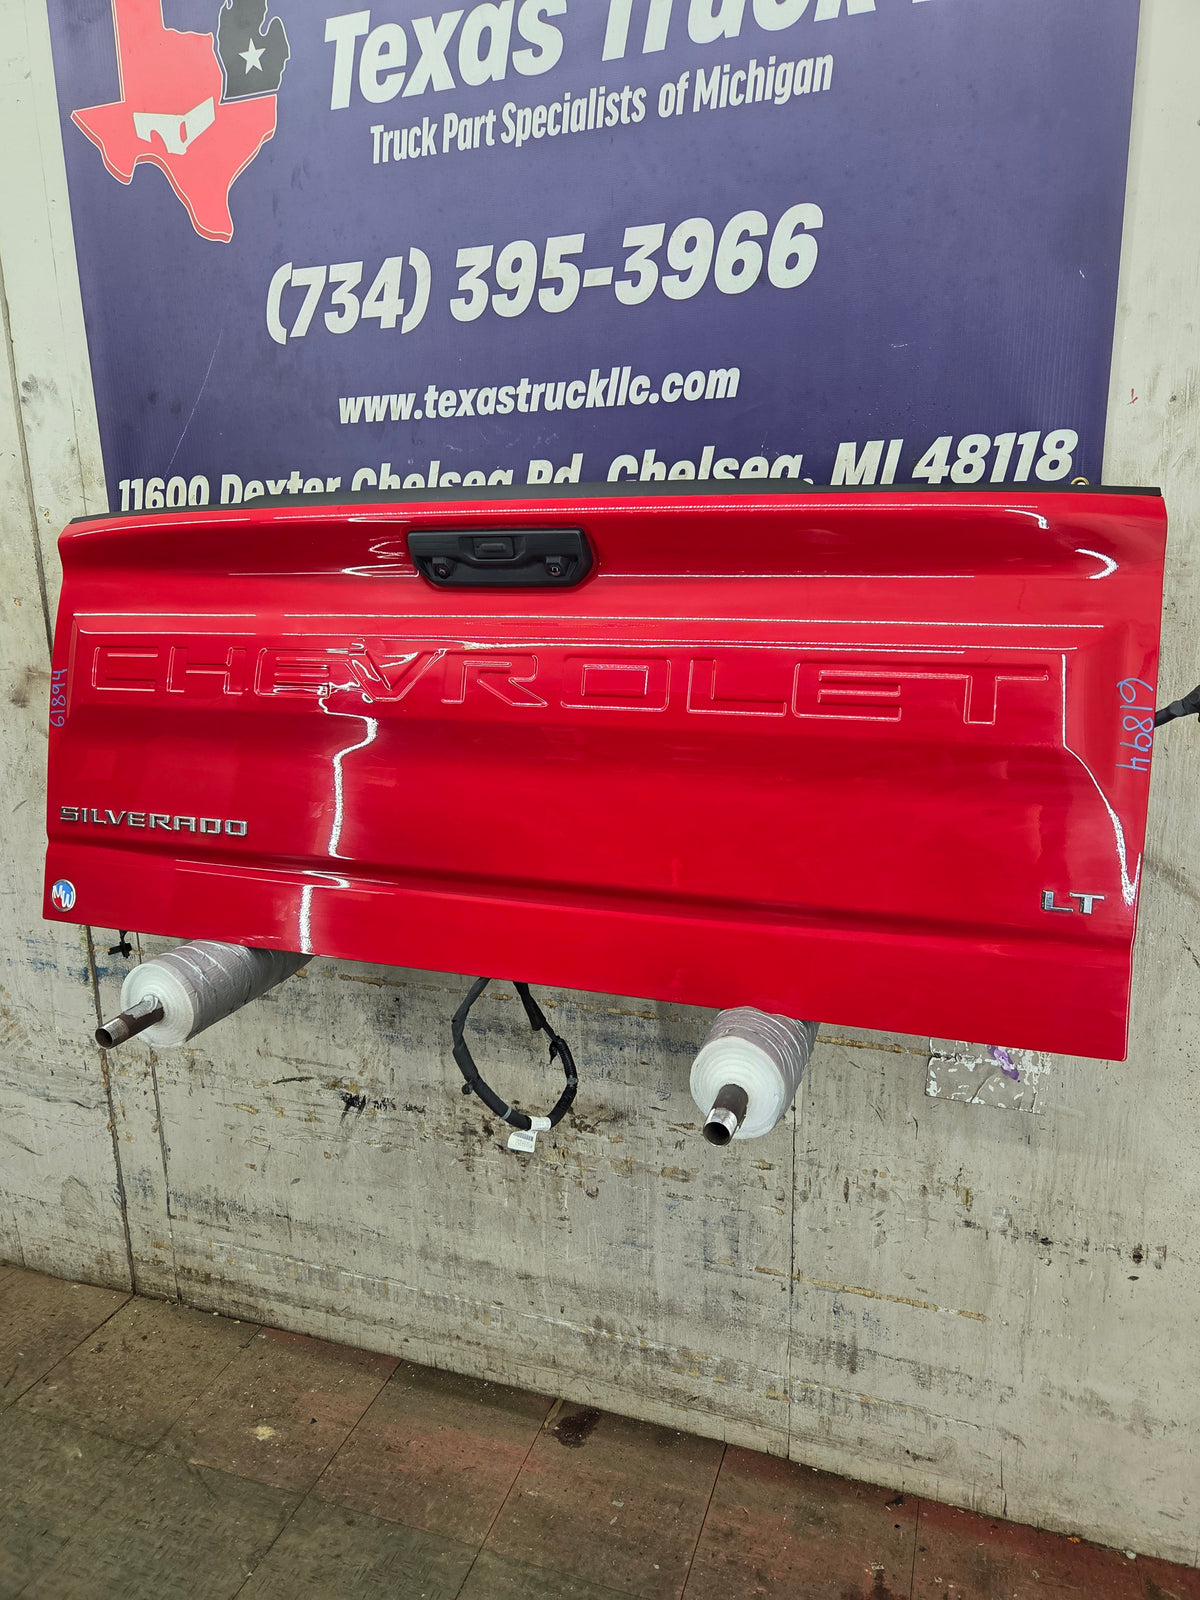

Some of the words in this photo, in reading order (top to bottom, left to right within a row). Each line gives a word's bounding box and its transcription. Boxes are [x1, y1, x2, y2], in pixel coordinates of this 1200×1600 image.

[324, 0, 567, 111] Texas
[601, 0, 877, 62] Tru
[370, 117, 438, 164] Truck
[442, 109, 497, 154] Part
[500, 83, 647, 147] Specialists
[657, 71, 689, 119] of
[692, 53, 834, 113] Michigan
[266, 247, 431, 345] (734)
[449, 203, 824, 322] 395-3966
[338, 365, 740, 424] www.texastruckllc.com
[118, 474, 210, 511] 11600
[829, 438, 904, 485] MI
[911, 429, 1079, 485] 48118
[91, 643, 1049, 726] CHEVROLET
[1116, 677, 1155, 771] 61894
[60, 805, 248, 837] SILVERADO
[1041, 889, 1105, 914] LT
